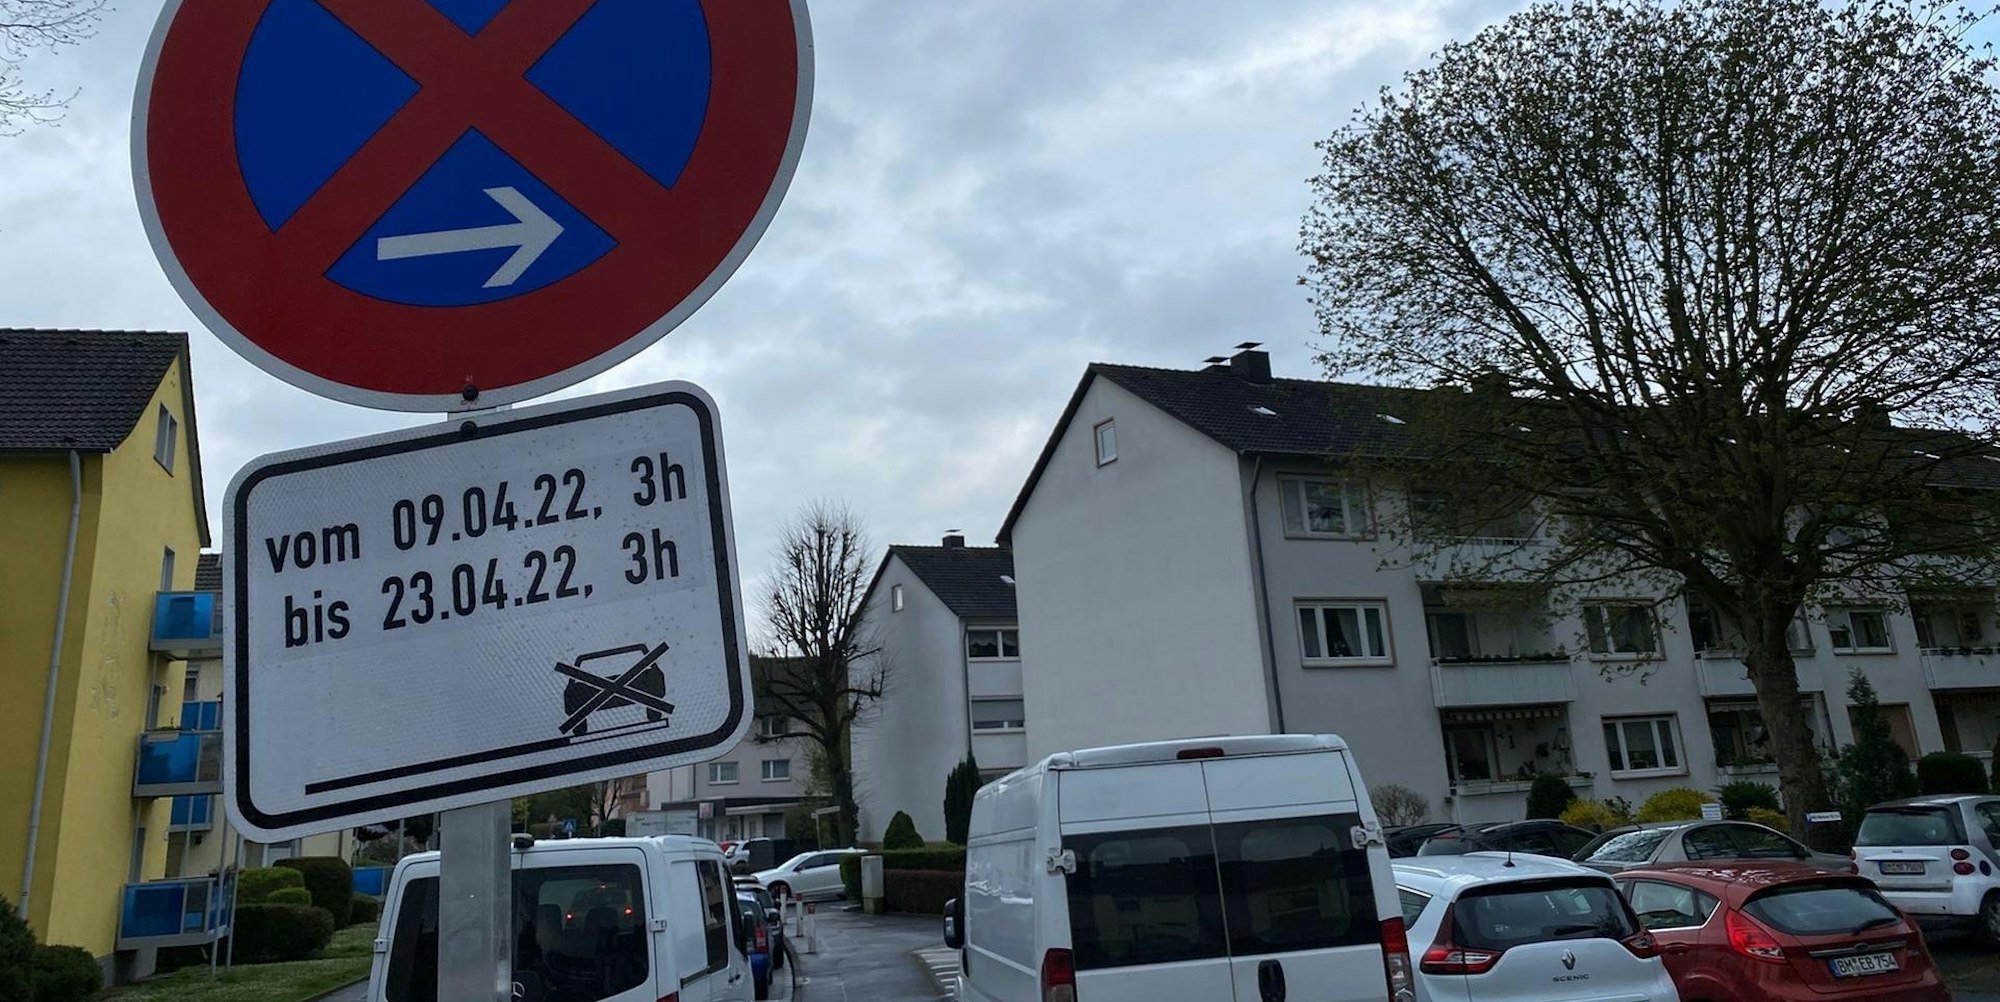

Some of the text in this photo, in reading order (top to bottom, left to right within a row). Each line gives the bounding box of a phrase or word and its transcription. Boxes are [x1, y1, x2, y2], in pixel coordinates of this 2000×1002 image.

[264, 522, 361, 574] vom
[630, 451, 688, 507] 3h
[284, 589, 351, 649] bis
[620, 527, 680, 585] 3h
[1837, 960, 1856, 973] BM
[1858, 957, 1875, 970] EB
